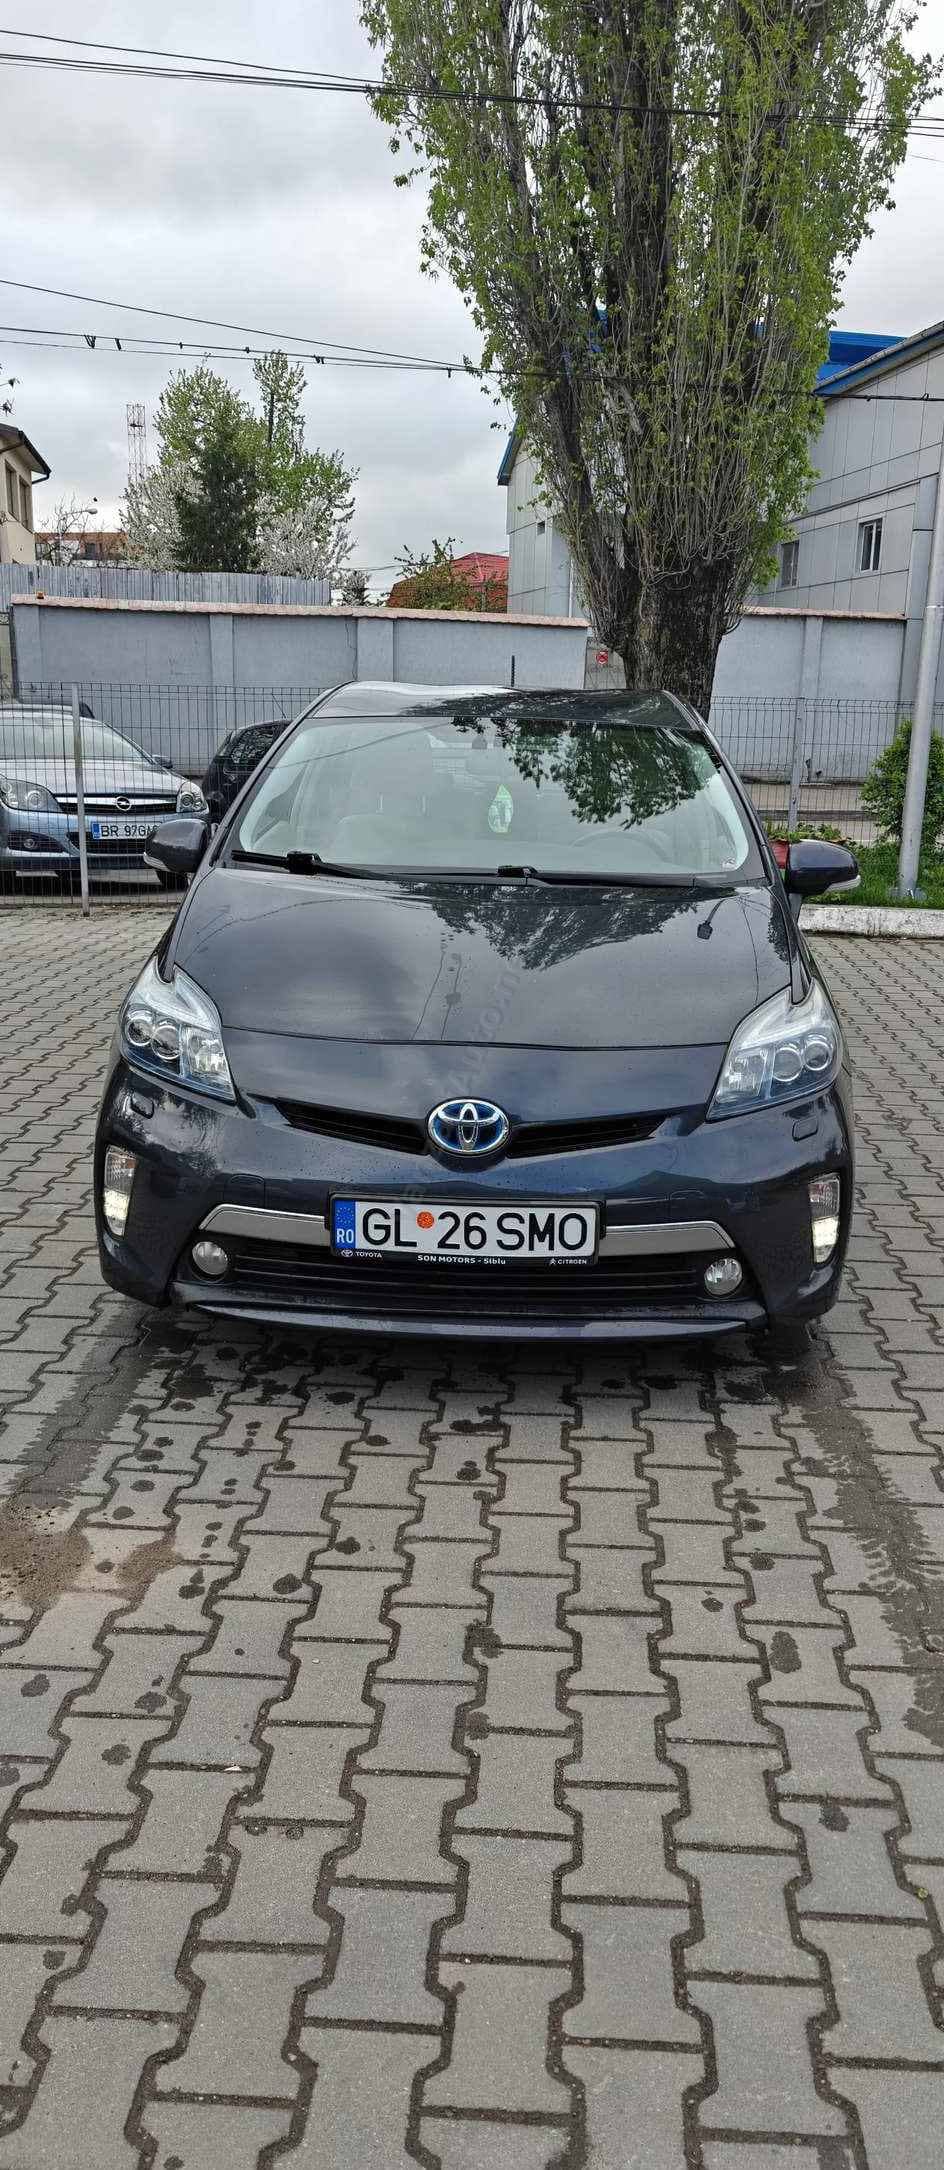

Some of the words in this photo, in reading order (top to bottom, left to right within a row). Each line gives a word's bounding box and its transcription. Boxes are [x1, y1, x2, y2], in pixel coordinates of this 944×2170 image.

[101, 825, 119, 837] BR
[336, 1228, 354, 1243] RO
[363, 1208, 418, 1247] GL
[438, 1212, 487, 1250] 26
[497, 1212, 588, 1251] SMO
[417, 1254, 437, 1262] SON
[438, 1256, 476, 1264] MOTORS
